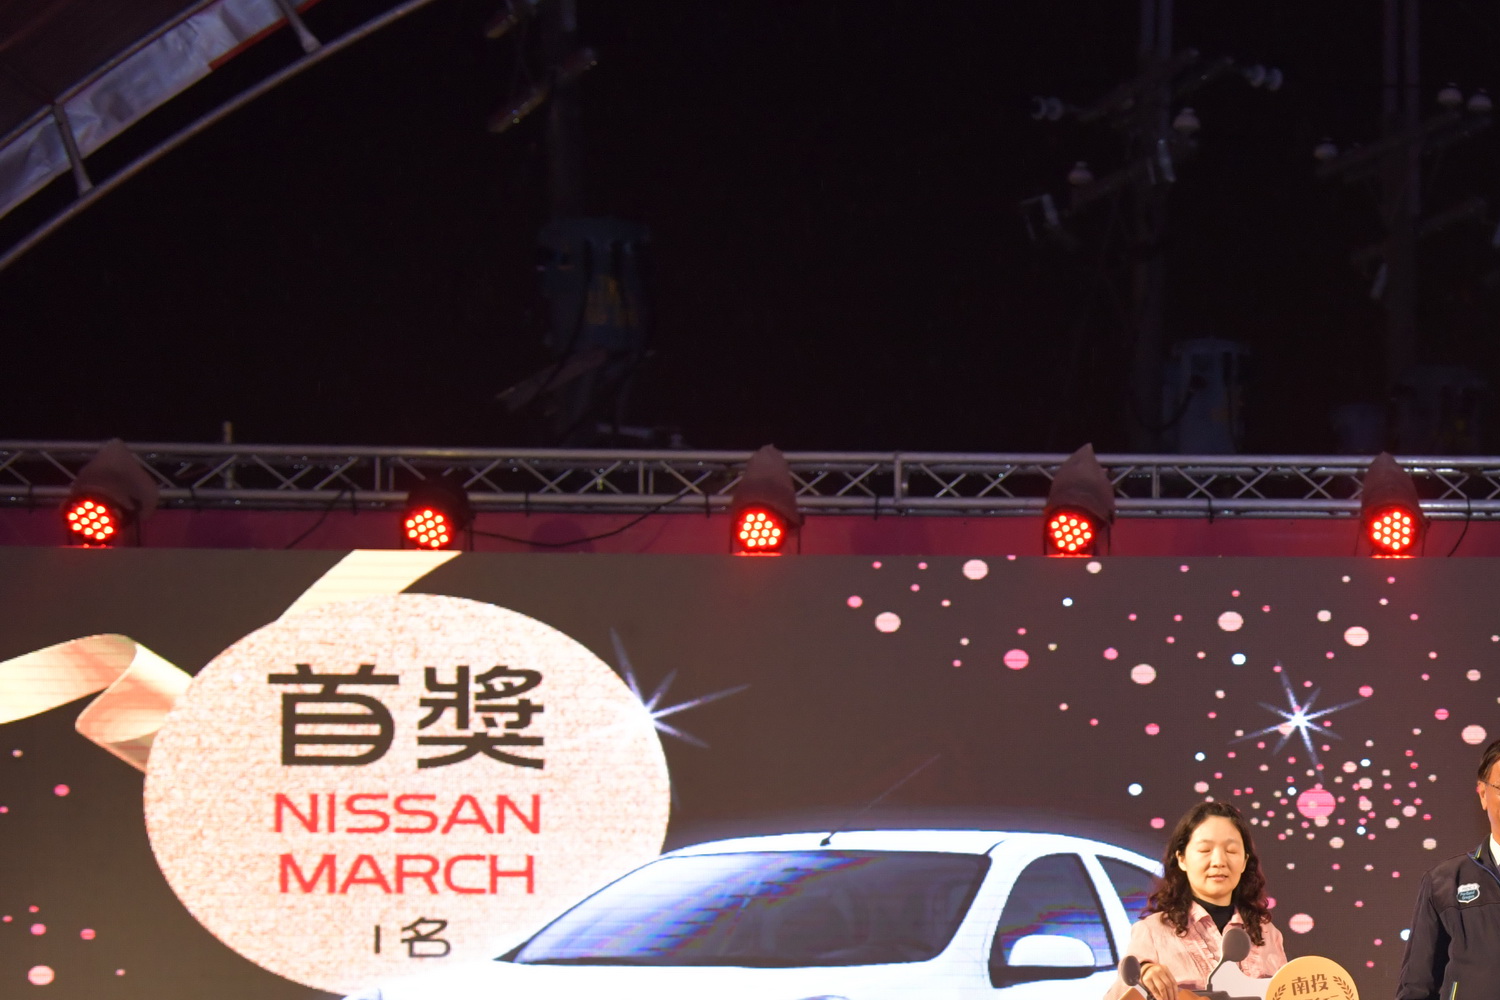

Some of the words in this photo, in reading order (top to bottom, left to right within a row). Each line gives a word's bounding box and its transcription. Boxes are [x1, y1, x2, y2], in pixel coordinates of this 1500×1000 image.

[268, 663, 544, 770] 首獎
[274, 792, 541, 835] NISSAN
[279, 853, 535, 895] MARCH
[1291, 973, 1329, 996] 南投
